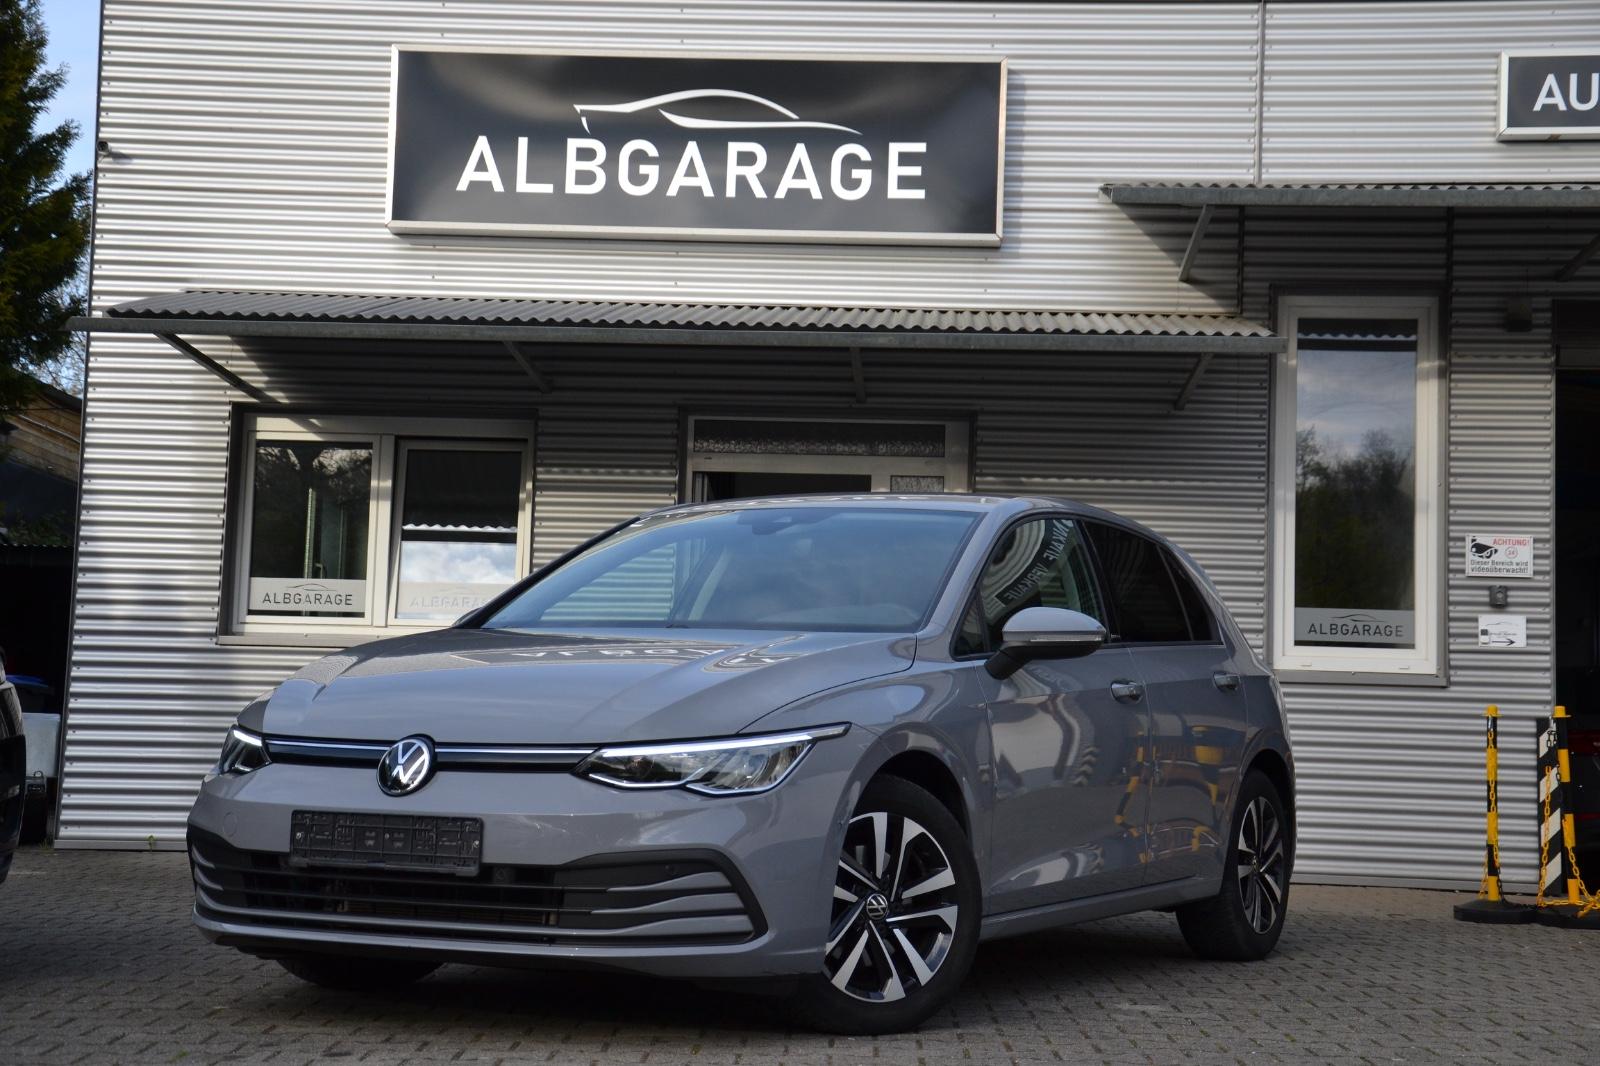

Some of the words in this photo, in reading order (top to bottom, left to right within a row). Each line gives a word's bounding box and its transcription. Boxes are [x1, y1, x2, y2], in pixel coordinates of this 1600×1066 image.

[1532, 72, 1600, 111] AU
[455, 135, 927, 201] ALBGARAGE
[262, 592, 353, 606] ALBGARAGE
[1307, 623, 1405, 637] ALBGARAGE
